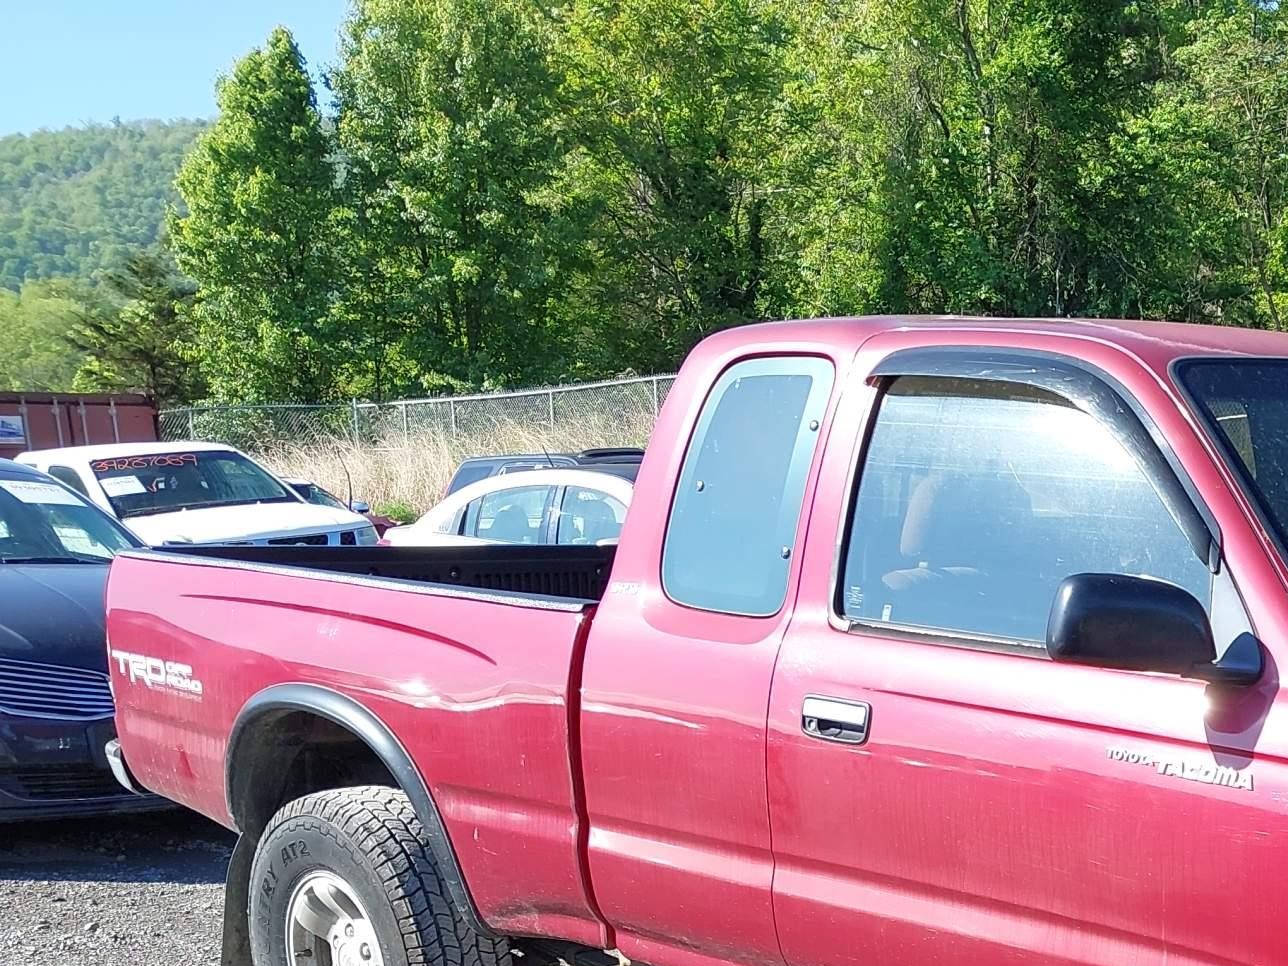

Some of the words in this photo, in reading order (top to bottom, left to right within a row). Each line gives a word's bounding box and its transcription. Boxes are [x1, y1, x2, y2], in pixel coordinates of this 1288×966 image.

[111, 649, 166, 689] TRD
[166, 674, 203, 695] ROAD
[1156, 757, 1254, 791] TACOMA
[280, 839, 312, 869] AT2
